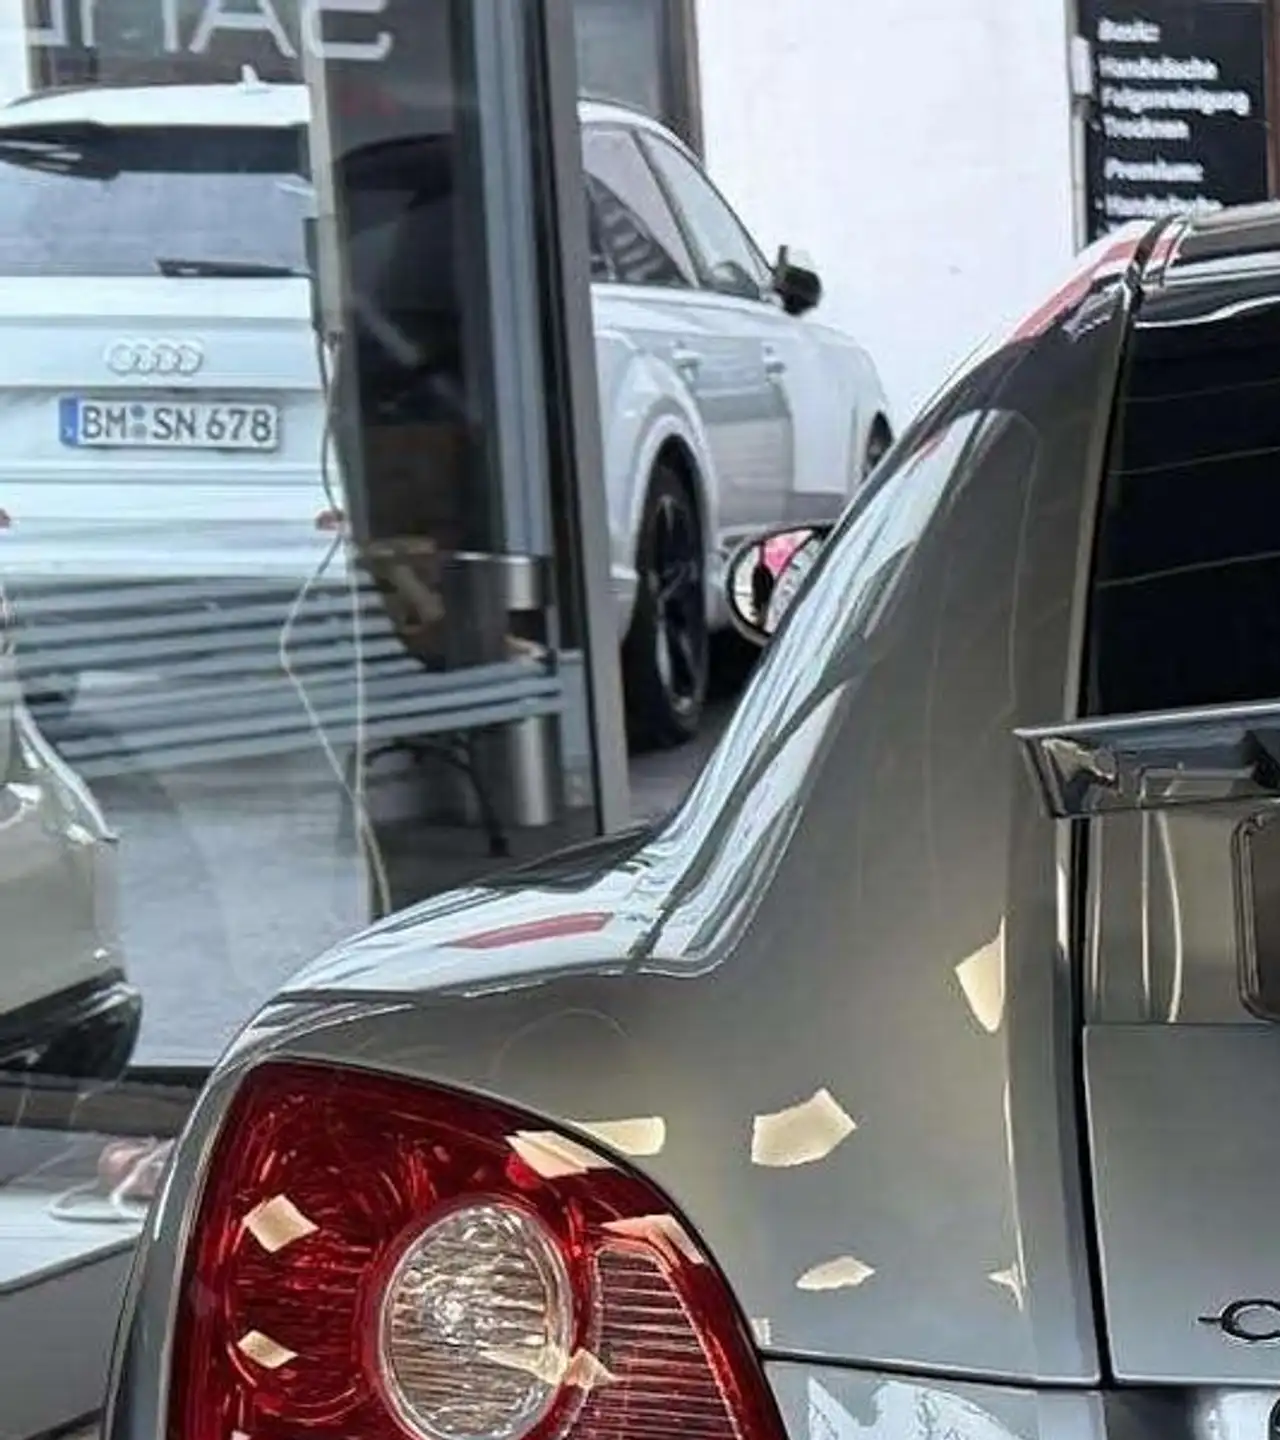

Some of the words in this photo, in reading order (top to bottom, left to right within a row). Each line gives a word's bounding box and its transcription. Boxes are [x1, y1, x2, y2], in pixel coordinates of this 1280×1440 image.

[82, 405, 126, 439] BM
[153, 407, 196, 440] SN
[206, 408, 273, 443] 678
